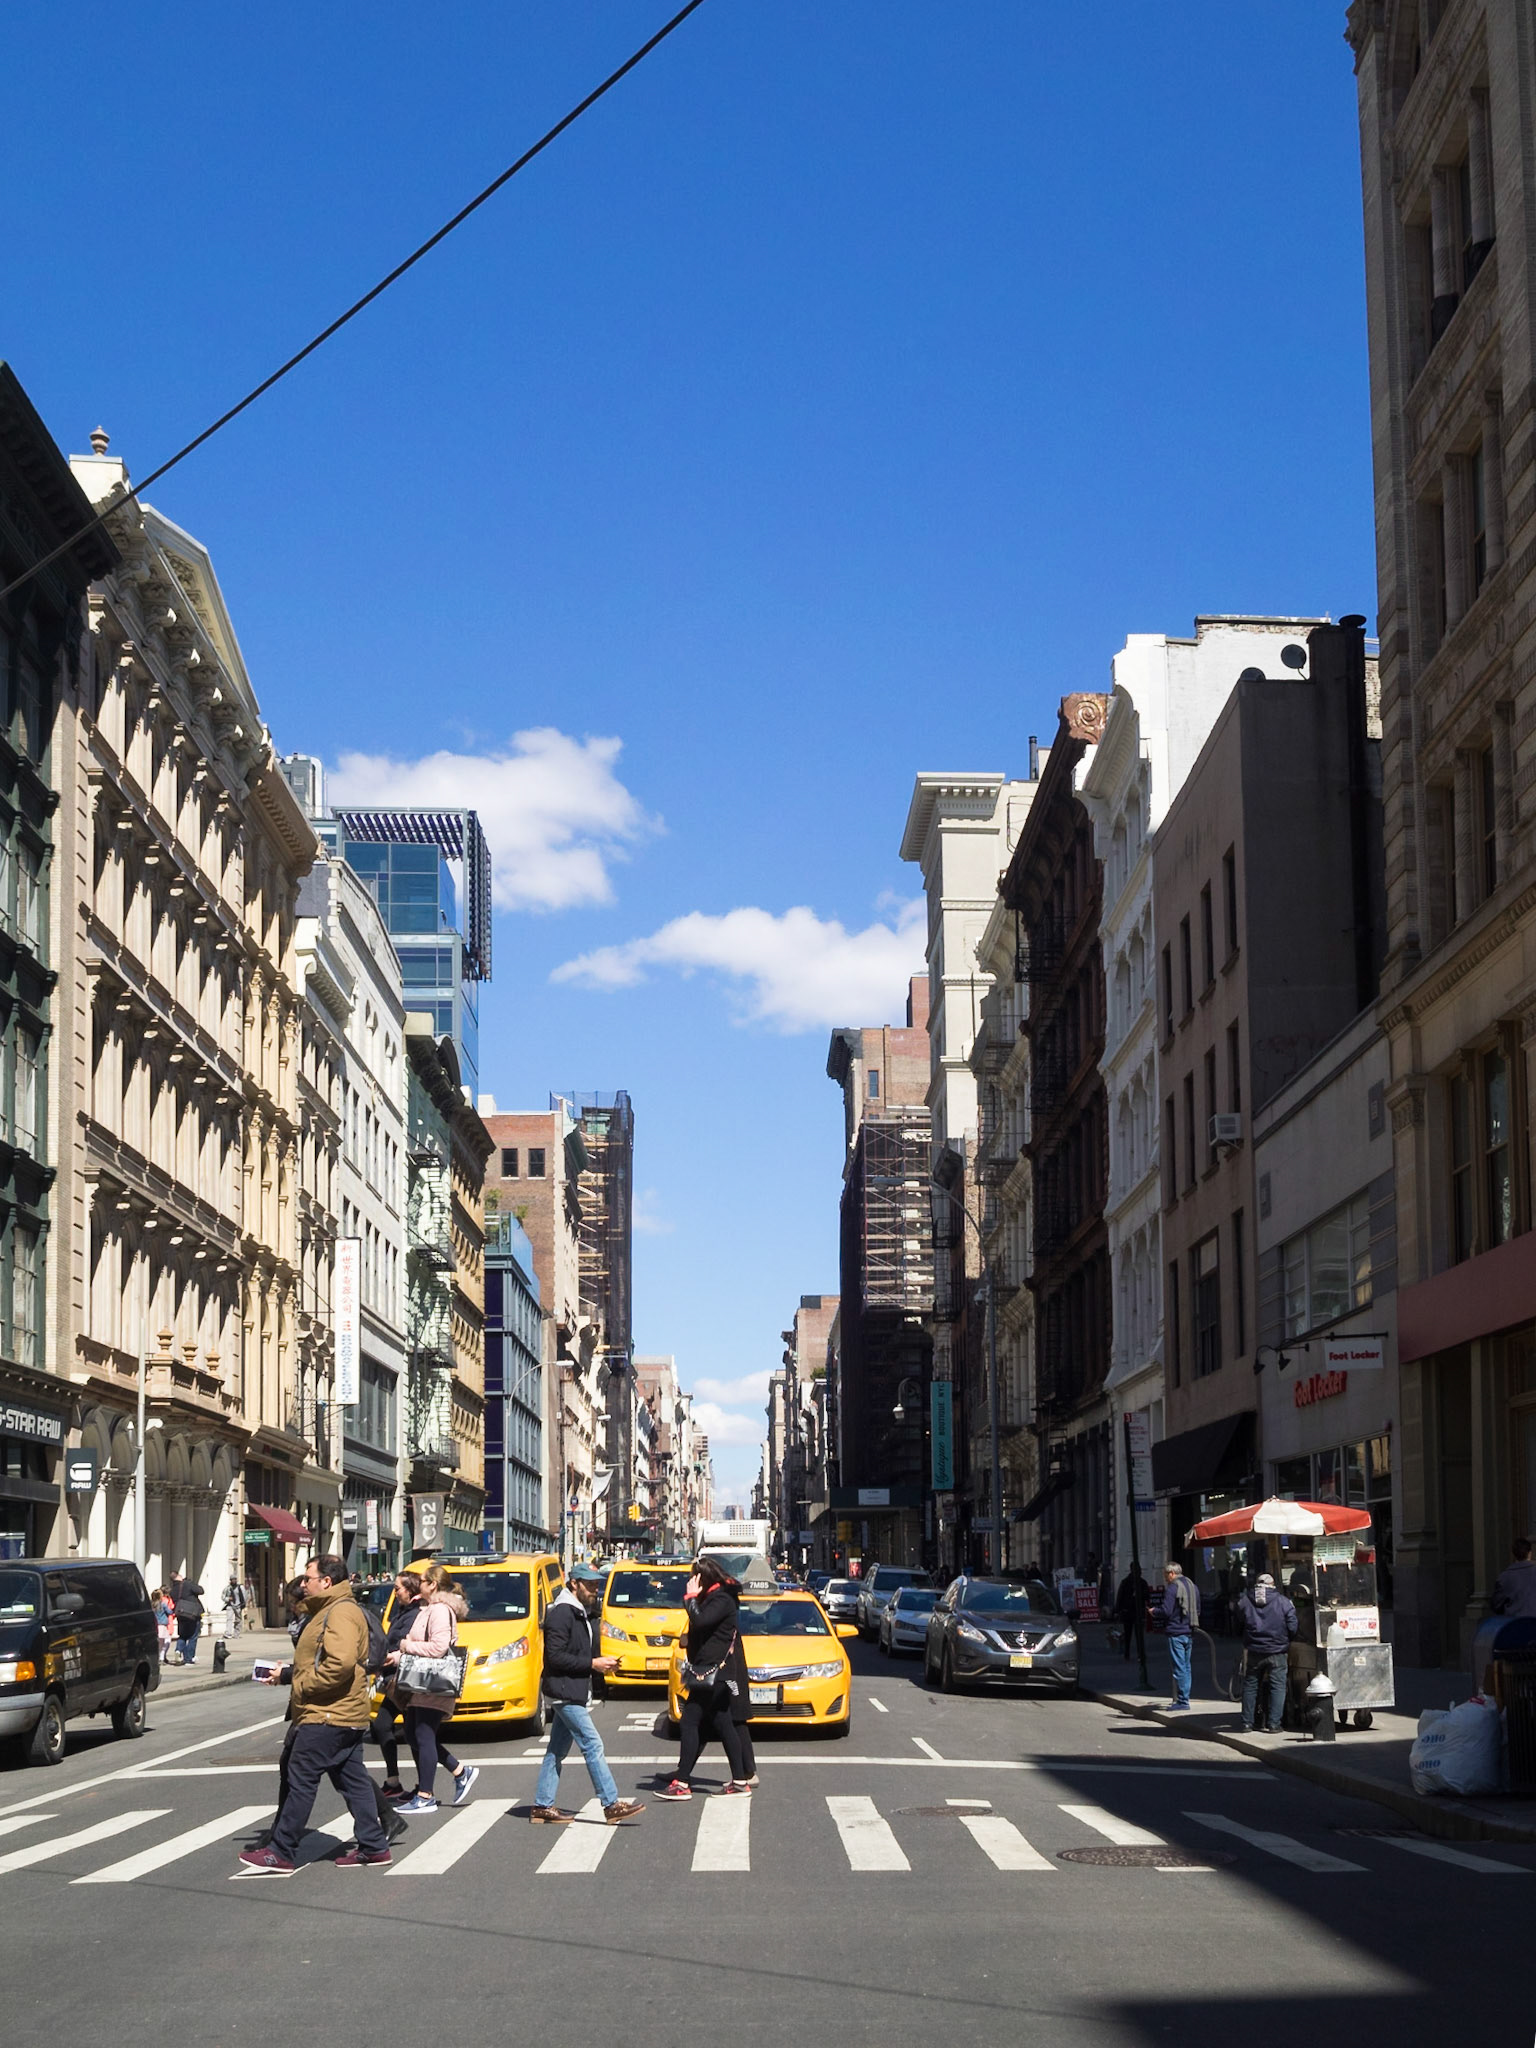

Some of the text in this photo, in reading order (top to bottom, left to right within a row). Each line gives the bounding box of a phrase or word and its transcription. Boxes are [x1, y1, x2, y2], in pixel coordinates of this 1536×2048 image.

[1329, 1350, 1380, 1360] Foot Locker
[1294, 1370, 1348, 1408] Foot Locker
[0, 1406, 61, 1440] -STAR RAW
[421, 1502, 437, 1541] CB2
[1077, 1599, 1097, 1607] SALE
